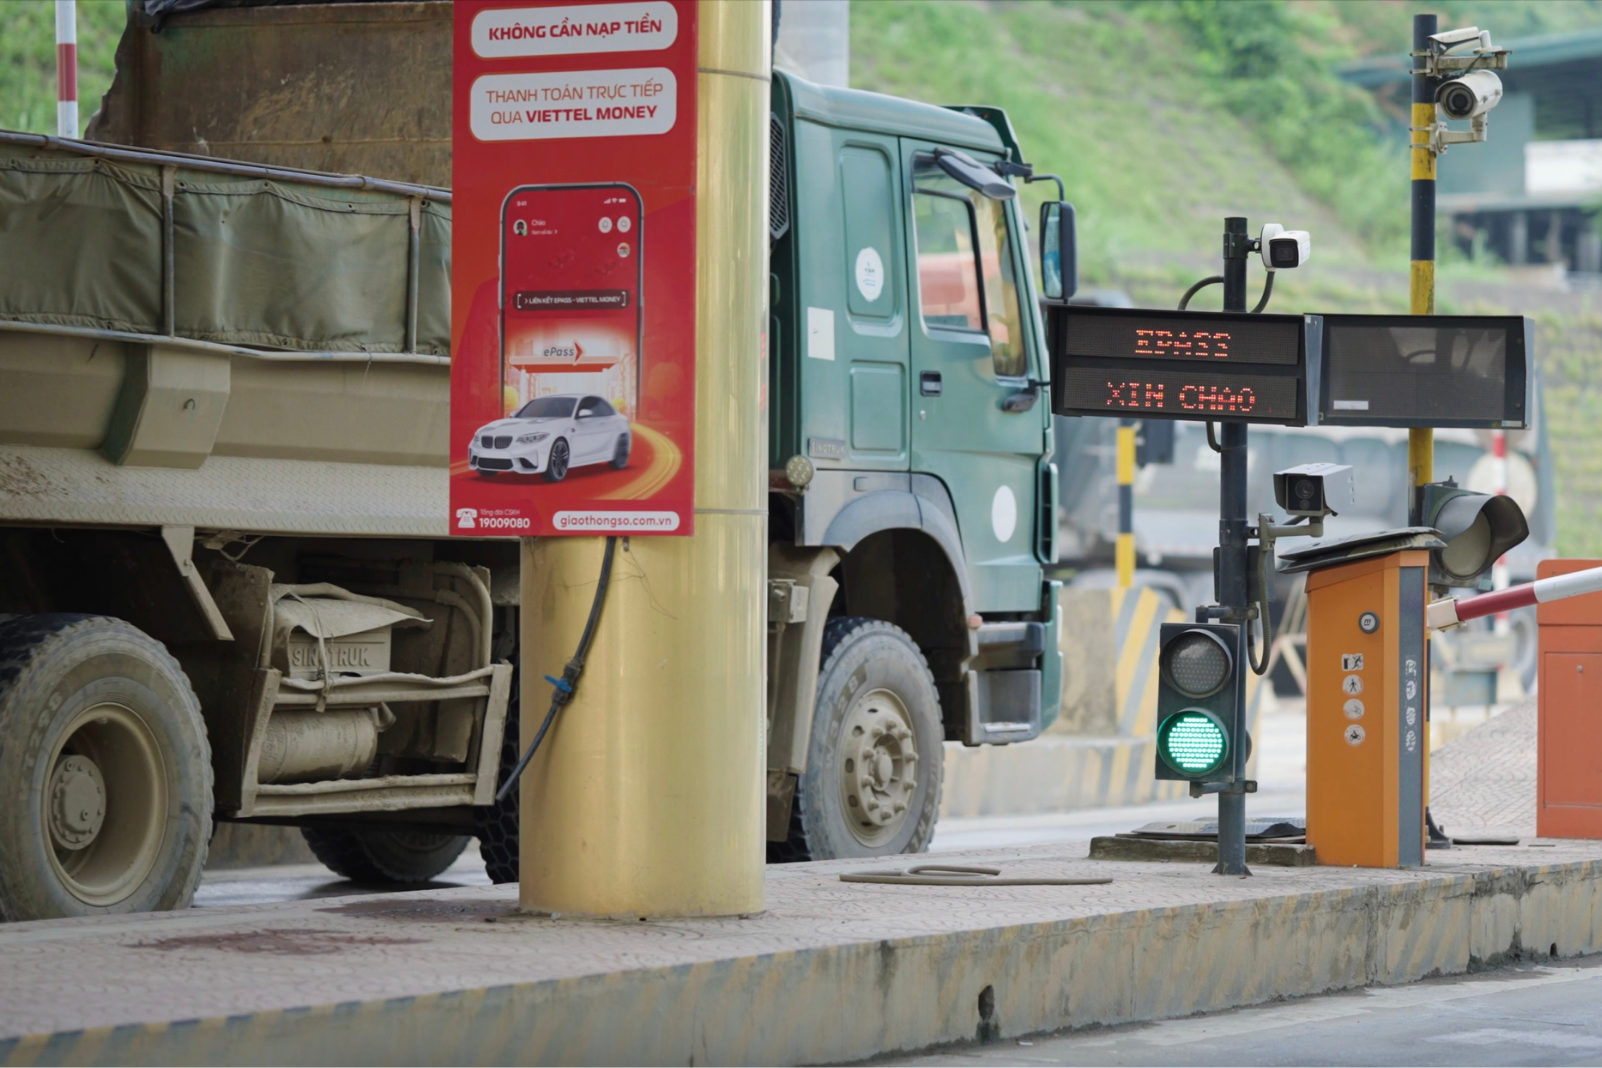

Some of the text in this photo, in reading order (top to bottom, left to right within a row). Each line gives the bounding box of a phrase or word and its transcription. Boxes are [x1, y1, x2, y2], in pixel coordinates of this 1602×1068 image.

[489, 13, 662, 40] KHÔNG CẦN NẠP TIỀN
[486, 78, 663, 104] THANH TOÁN TRỰC TIẾP
[491, 105, 658, 125] QUA VIETTEL MONEY
[543, 346, 575, 357] ePass
[1135, 329, 1231, 358] EPASS
[1107, 381, 1256, 412] XIN CHAO
[479, 518, 530, 528] 19009080
[560, 515, 672, 528] giaothongso.com.vn
[292, 647, 370, 667] SINTRUK
